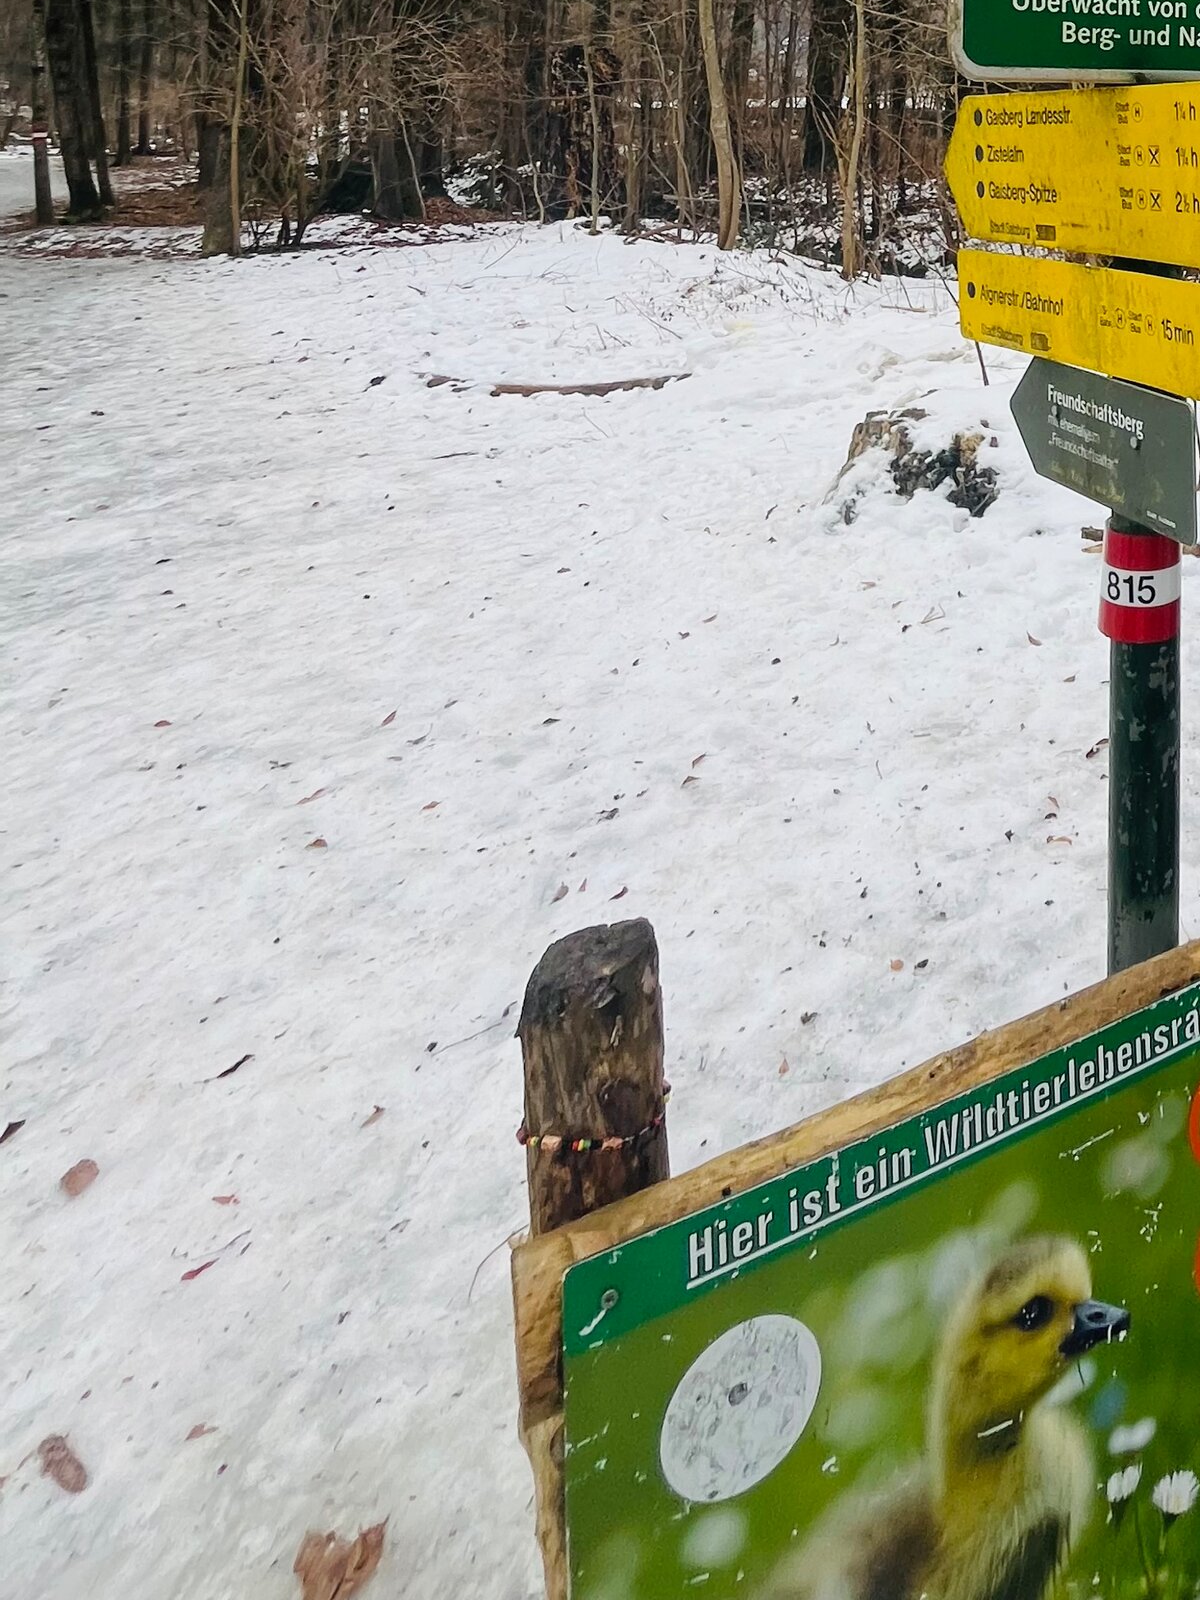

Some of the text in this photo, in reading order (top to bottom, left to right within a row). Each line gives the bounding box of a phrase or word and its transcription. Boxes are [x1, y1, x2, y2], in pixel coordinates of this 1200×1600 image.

[1148, 0, 1187, 19] von
[1062, 21, 1121, 50] Berg-
[1129, 24, 1170, 46] und
[1174, 324, 1194, 346] min
[1047, 384, 1144, 440] Freundschaftsberg
[1107, 571, 1156, 605] 815
[687, 1212, 774, 1280] Hier
[789, 1176, 841, 1233] ist
[855, 1147, 912, 1201] ein
